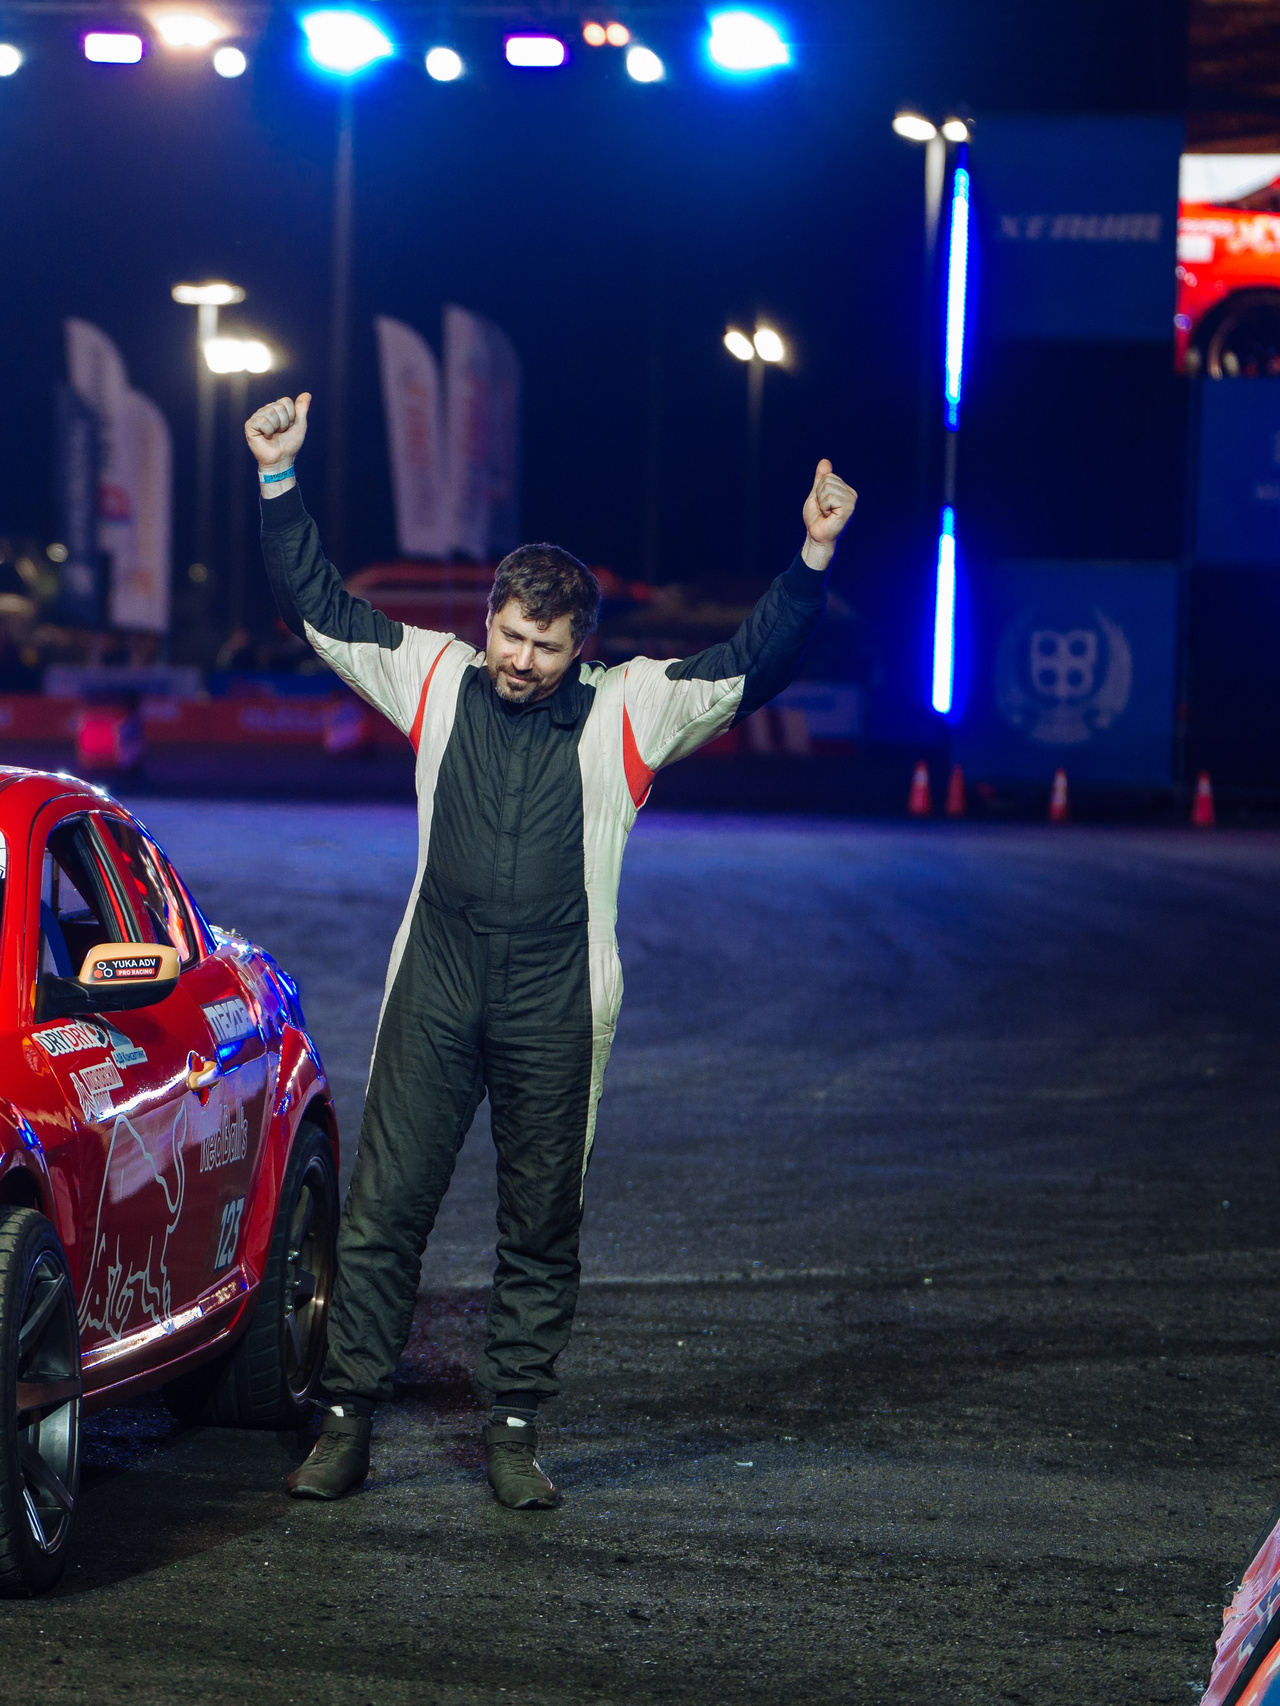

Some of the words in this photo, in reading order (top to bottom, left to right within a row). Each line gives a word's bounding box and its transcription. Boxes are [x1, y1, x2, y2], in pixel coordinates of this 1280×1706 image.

[112, 960, 138, 968] YUKA
[139, 958, 156, 967] ADV
[214, 1197, 245, 1270] 123
